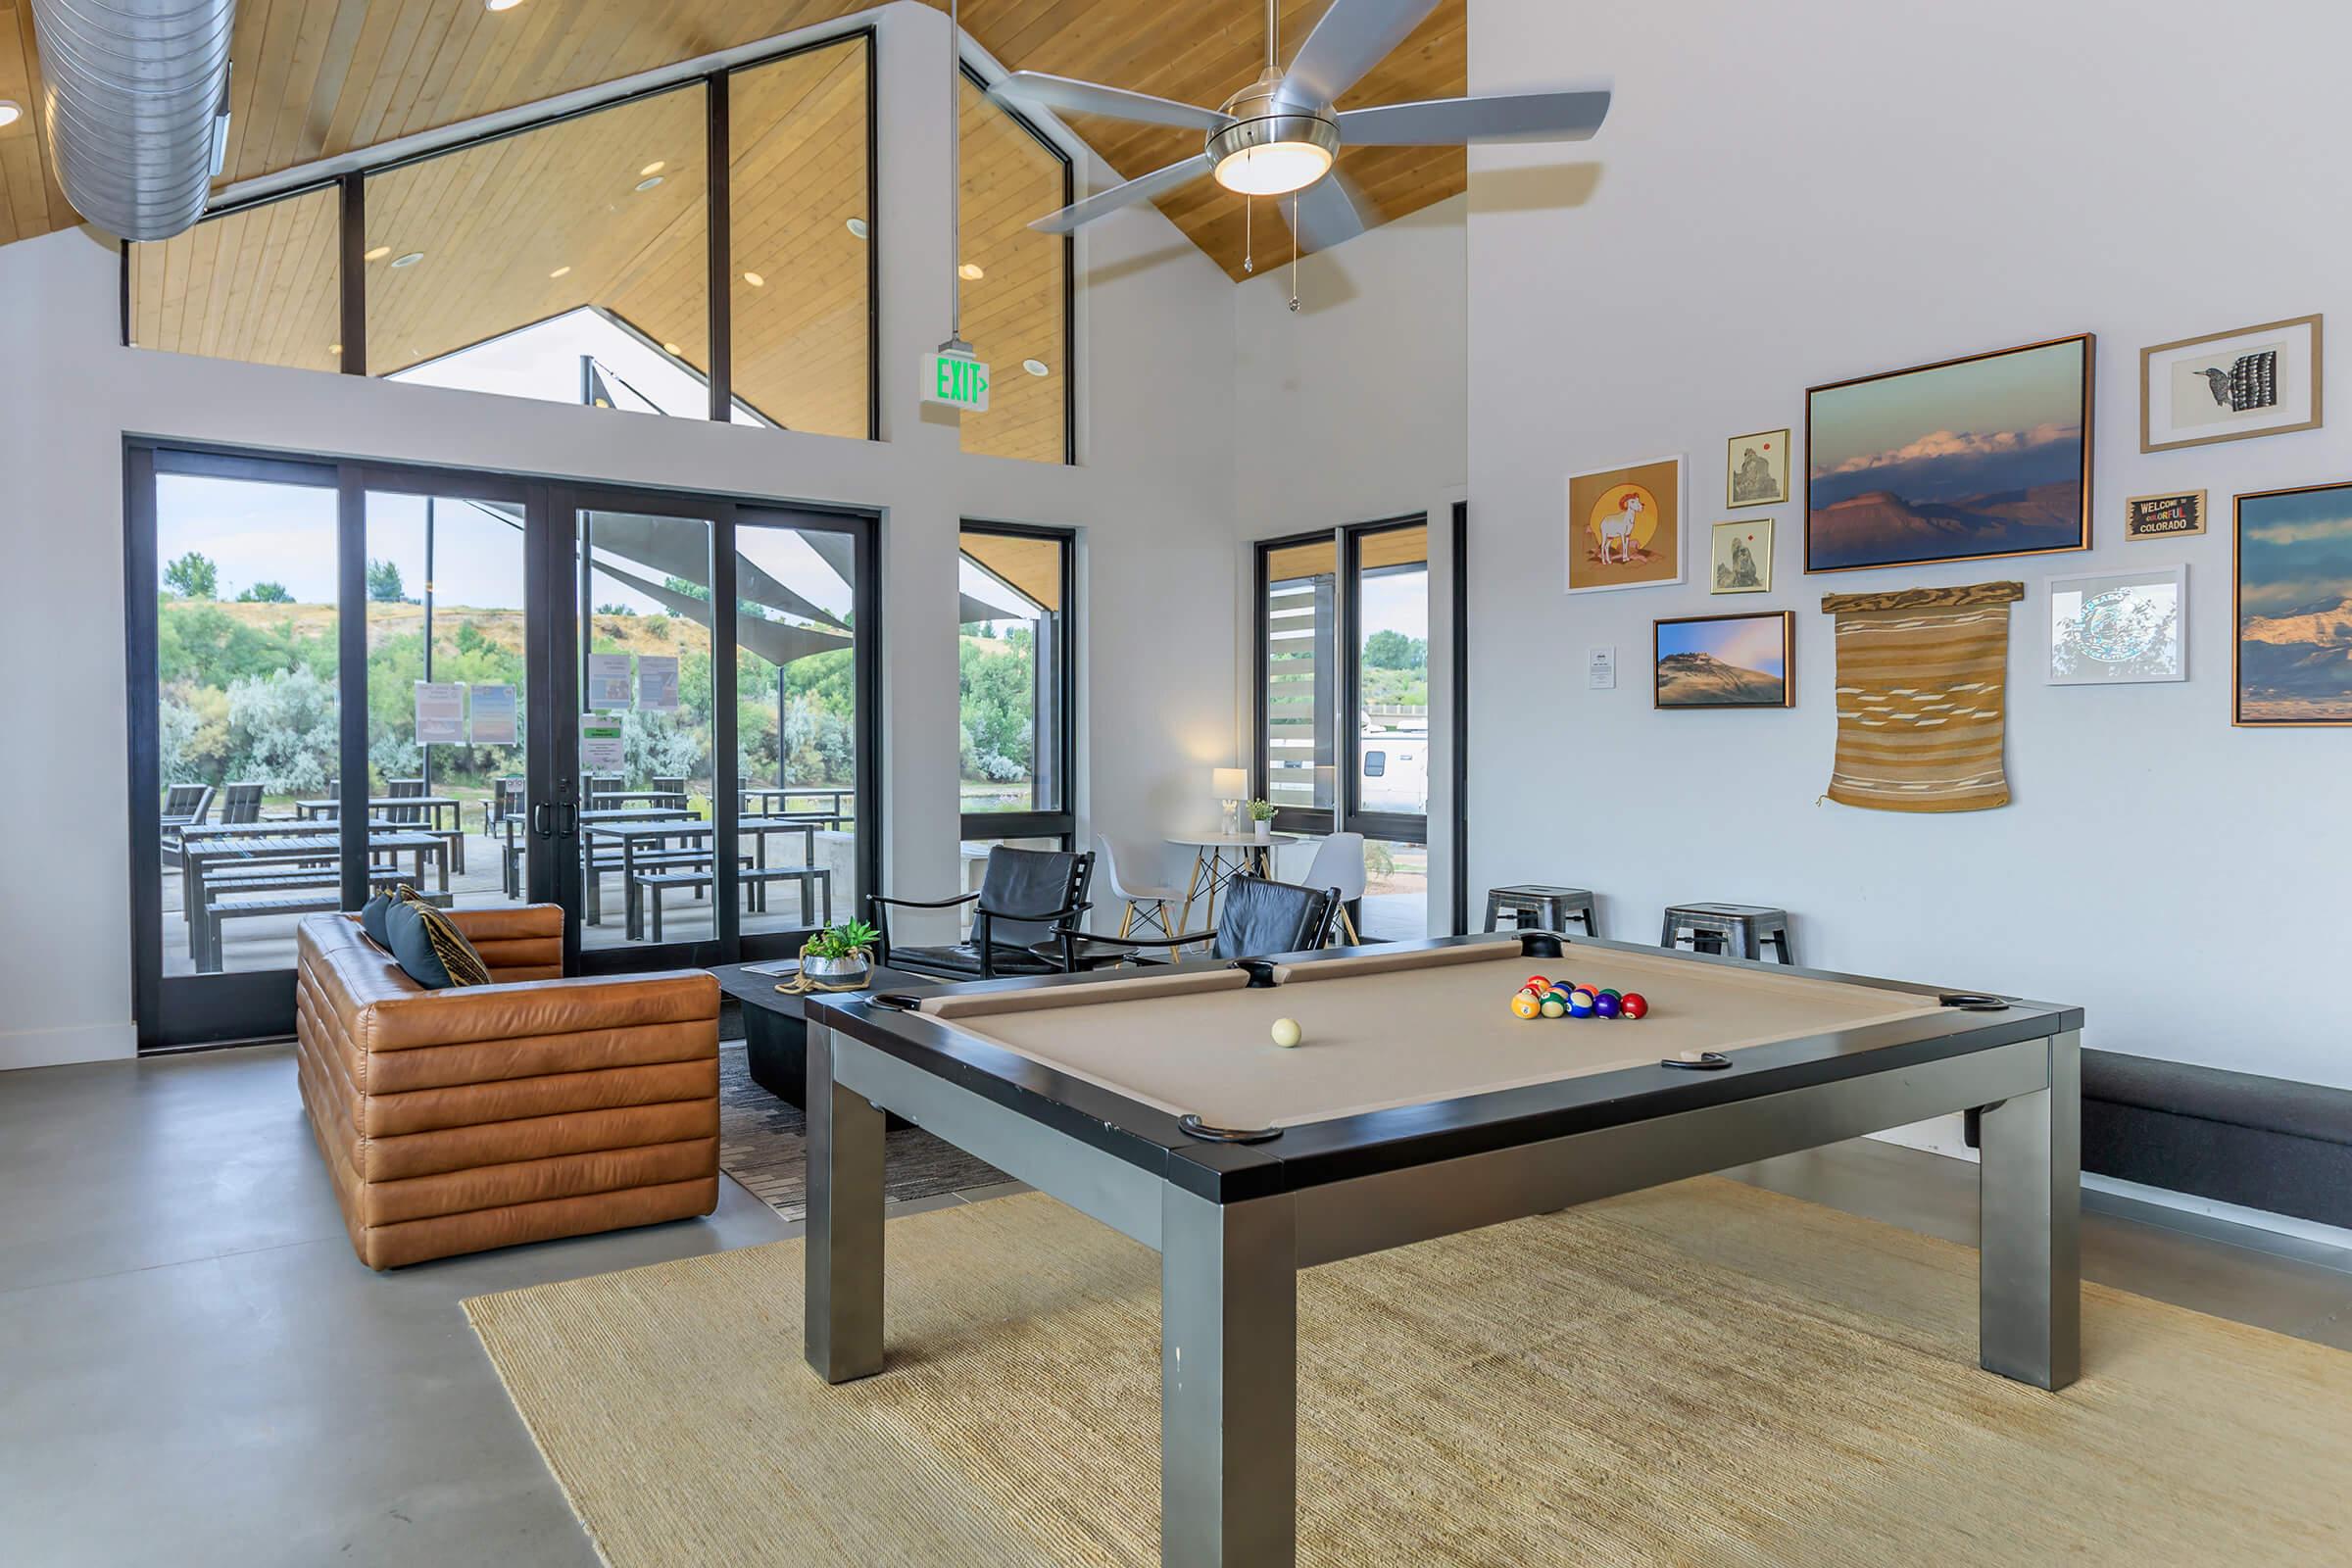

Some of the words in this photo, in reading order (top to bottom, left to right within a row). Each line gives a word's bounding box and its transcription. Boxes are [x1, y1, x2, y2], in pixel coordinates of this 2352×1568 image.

[937, 357, 981, 404] EXIT
[2140, 500, 2178, 514] WELCOME
[2146, 507, 2186, 521] COLORFUL
[2140, 519, 2186, 533] COLORADO
